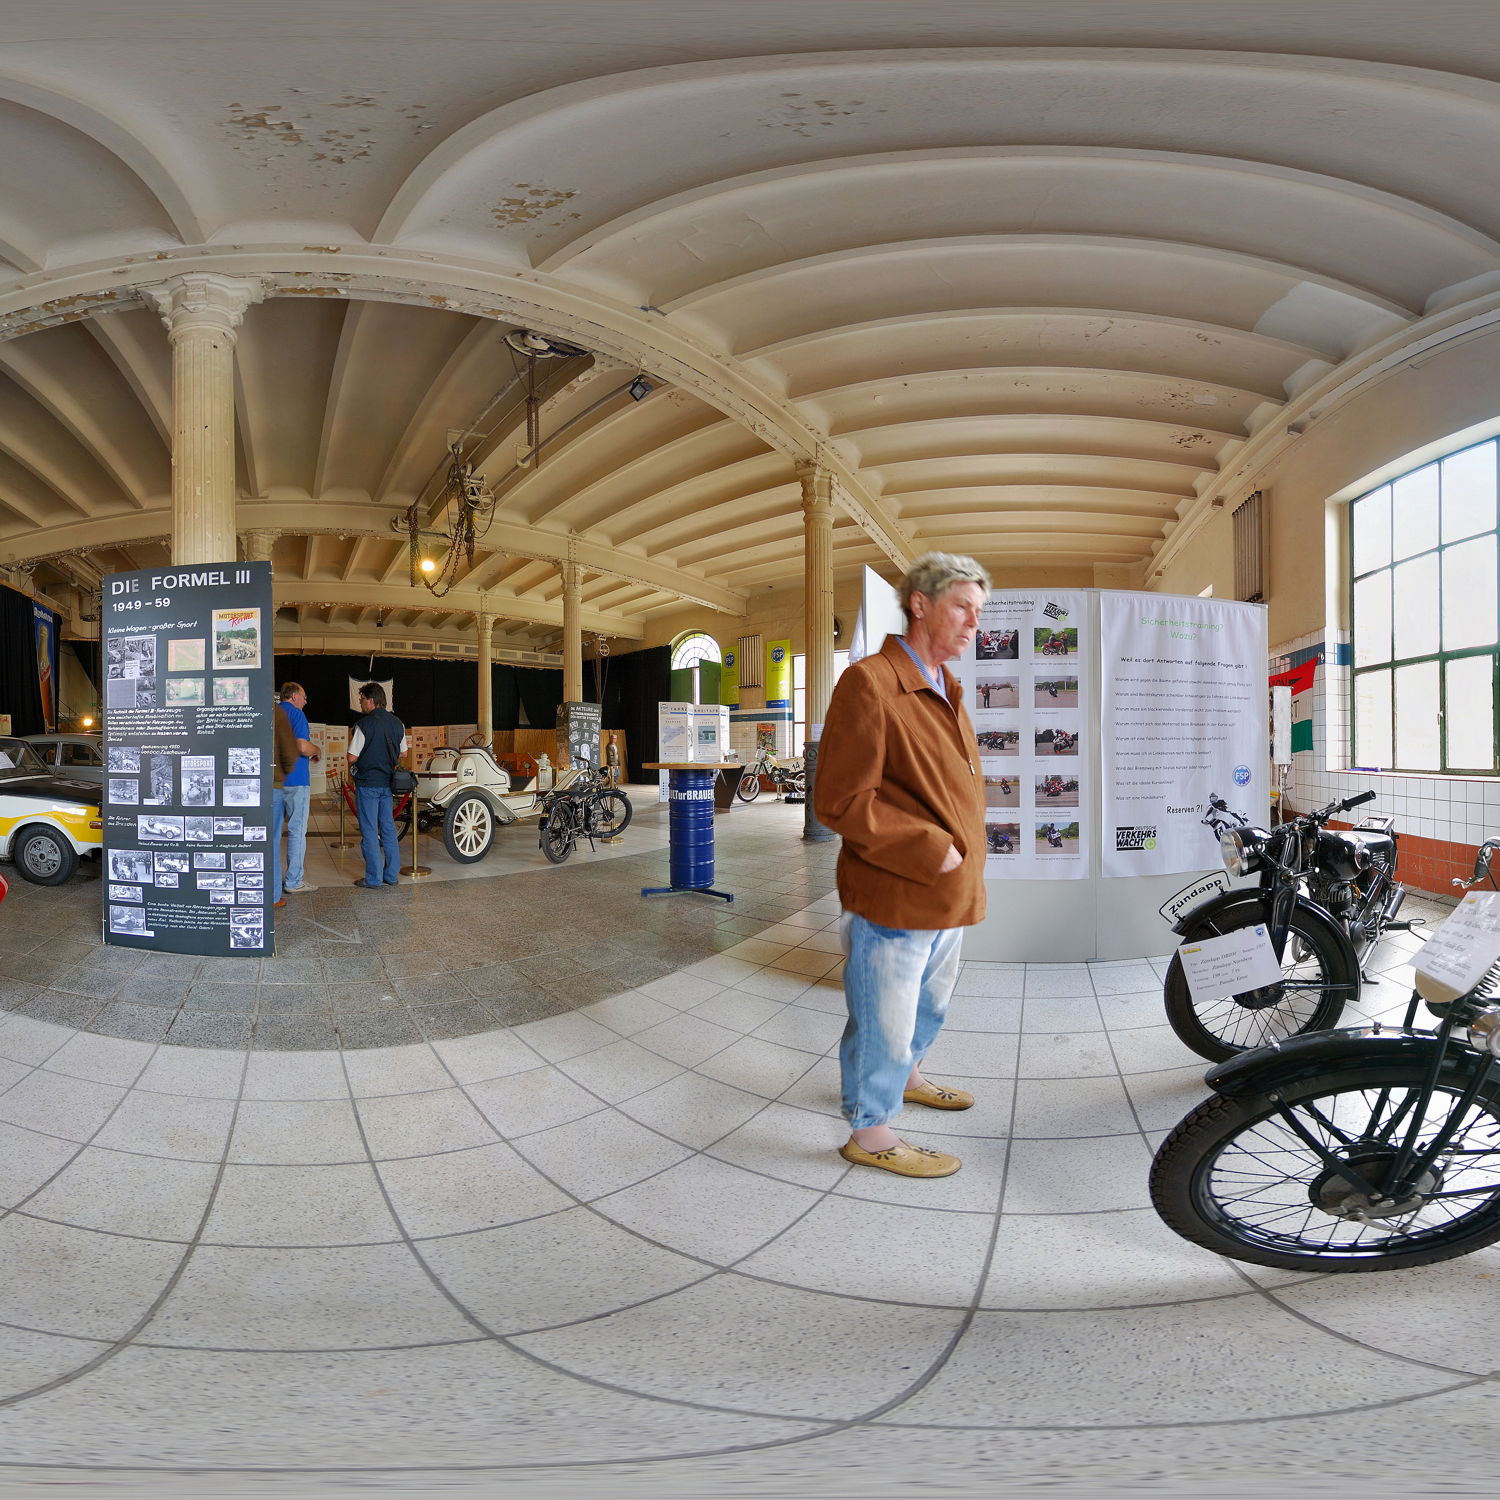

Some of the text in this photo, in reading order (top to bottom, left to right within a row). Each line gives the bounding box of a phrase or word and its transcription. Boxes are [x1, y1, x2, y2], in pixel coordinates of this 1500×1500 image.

[112, 570, 250, 596] DIE FORMEL III
[112, 600, 141, 612] 1949
[155, 597, 170, 608] 59
[108, 626, 126, 634] Kleine
[126, 625, 146, 633] Wagen
[177, 620, 197, 629] Sport
[1141, 617, 1224, 632] Sicherheitstraining?
[1170, 631, 1197, 641] Wozu?
[773, 651, 784, 659] FSP
[1194, 660, 1216, 668] folgende
[1217, 661, 1234, 669] Fragen
[792, 762, 801, 771] 14
[463, 768, 475, 777] Ford
[1235, 772, 1249, 781] FSP
[1166, 806, 1195, 814] Reserven
[1116, 830, 1157, 839] VERKEHRS
[1116, 838, 1145, 848] WACHT
[1168, 879, 1222, 915] Zündapp
